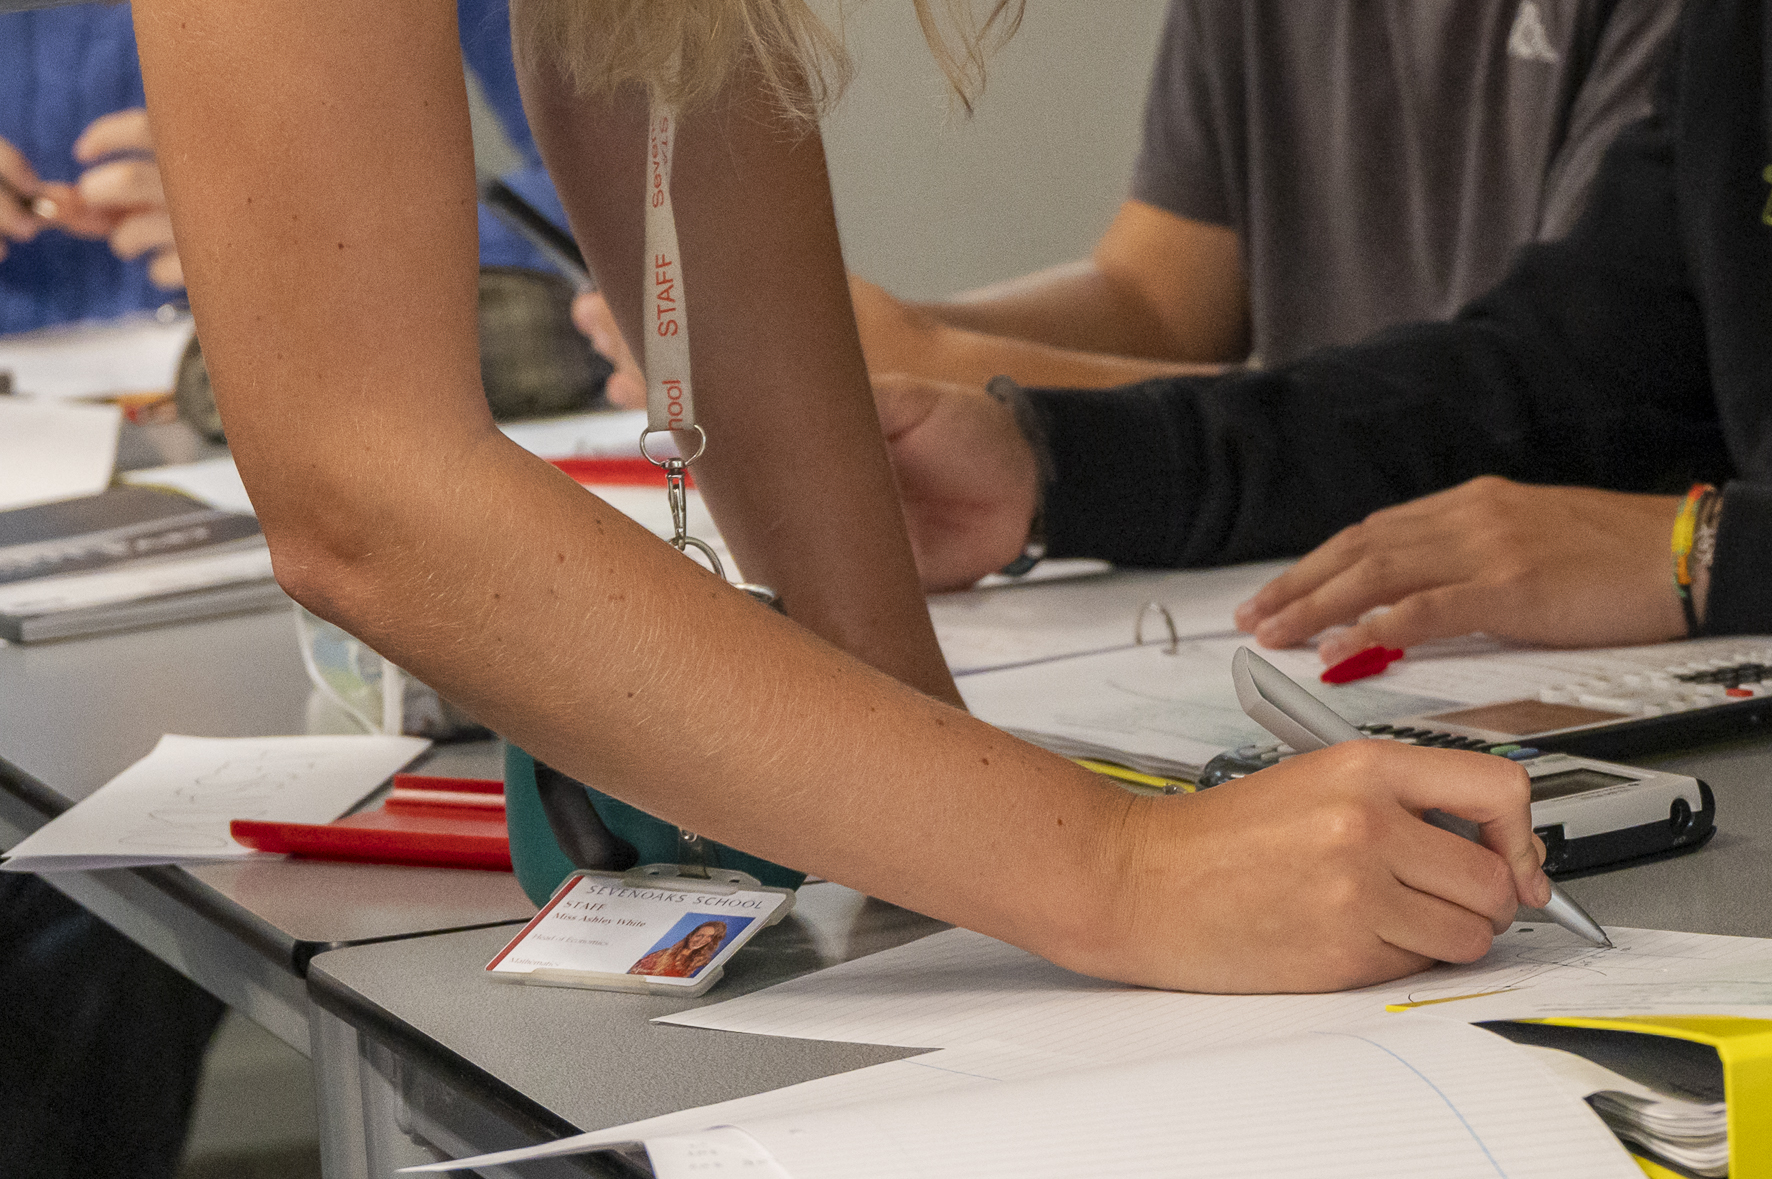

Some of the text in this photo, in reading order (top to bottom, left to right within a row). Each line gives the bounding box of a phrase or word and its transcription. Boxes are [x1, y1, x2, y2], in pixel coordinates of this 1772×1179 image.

[655, 253, 678, 337] STAFF
[662, 379, 683, 431] hool
[563, 901, 606, 911] STAFF
[586, 885, 763, 910] SEVENOAKS SCHOOL
[552, 912, 647, 928] Miss Ashley White
